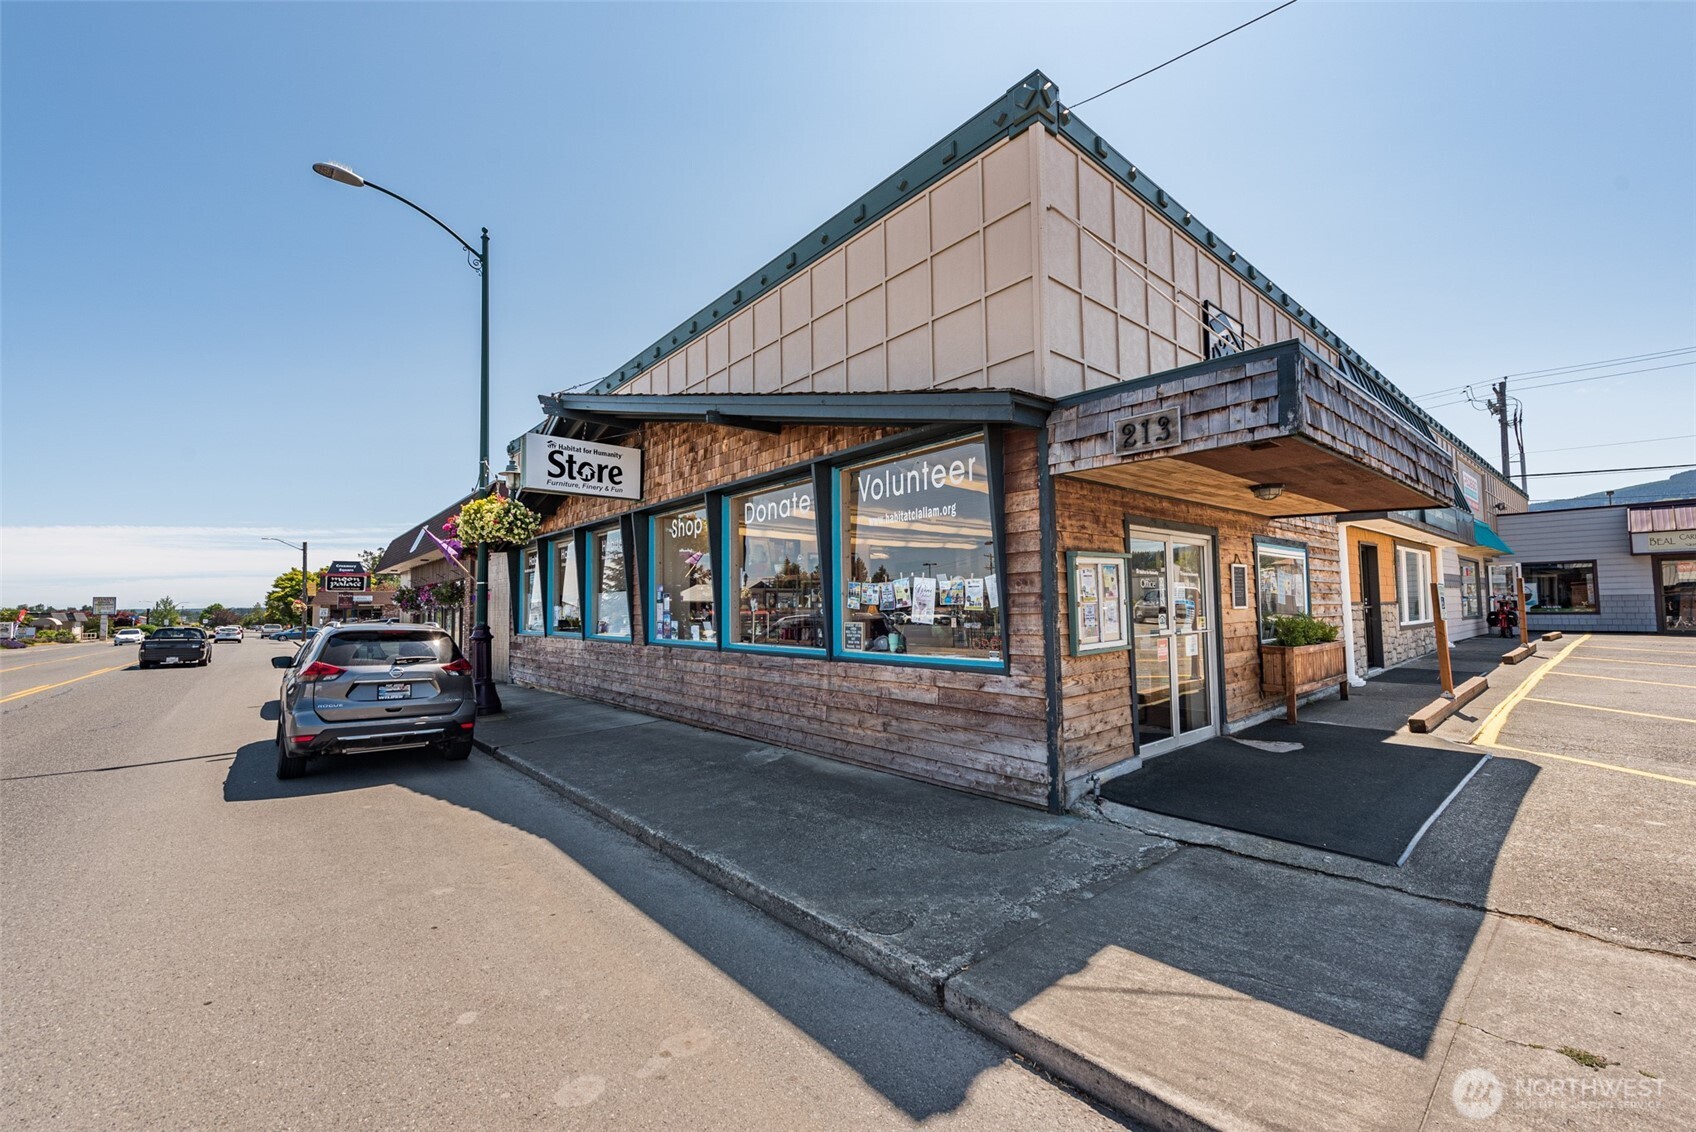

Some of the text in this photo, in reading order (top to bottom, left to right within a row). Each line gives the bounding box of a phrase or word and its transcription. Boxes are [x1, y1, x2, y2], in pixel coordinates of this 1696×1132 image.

[1122, 416, 1170, 448] 213
[558, 443, 582, 453] Habitat
[593, 449, 622, 459] Humanity
[548, 450, 623, 485] Store
[546, 479, 580, 489] Furniture,
[581, 483, 603, 492] Finery
[858, 456, 976, 502] Volunteer
[744, 491, 811, 525] Donate
[868, 502, 957, 527] www.habitatclallam.org
[671, 517, 703, 539] Shop
[1649, 537, 1676, 546] BEAL
[330, 580, 362, 589] palace
[1140, 578, 1156, 589] Office
